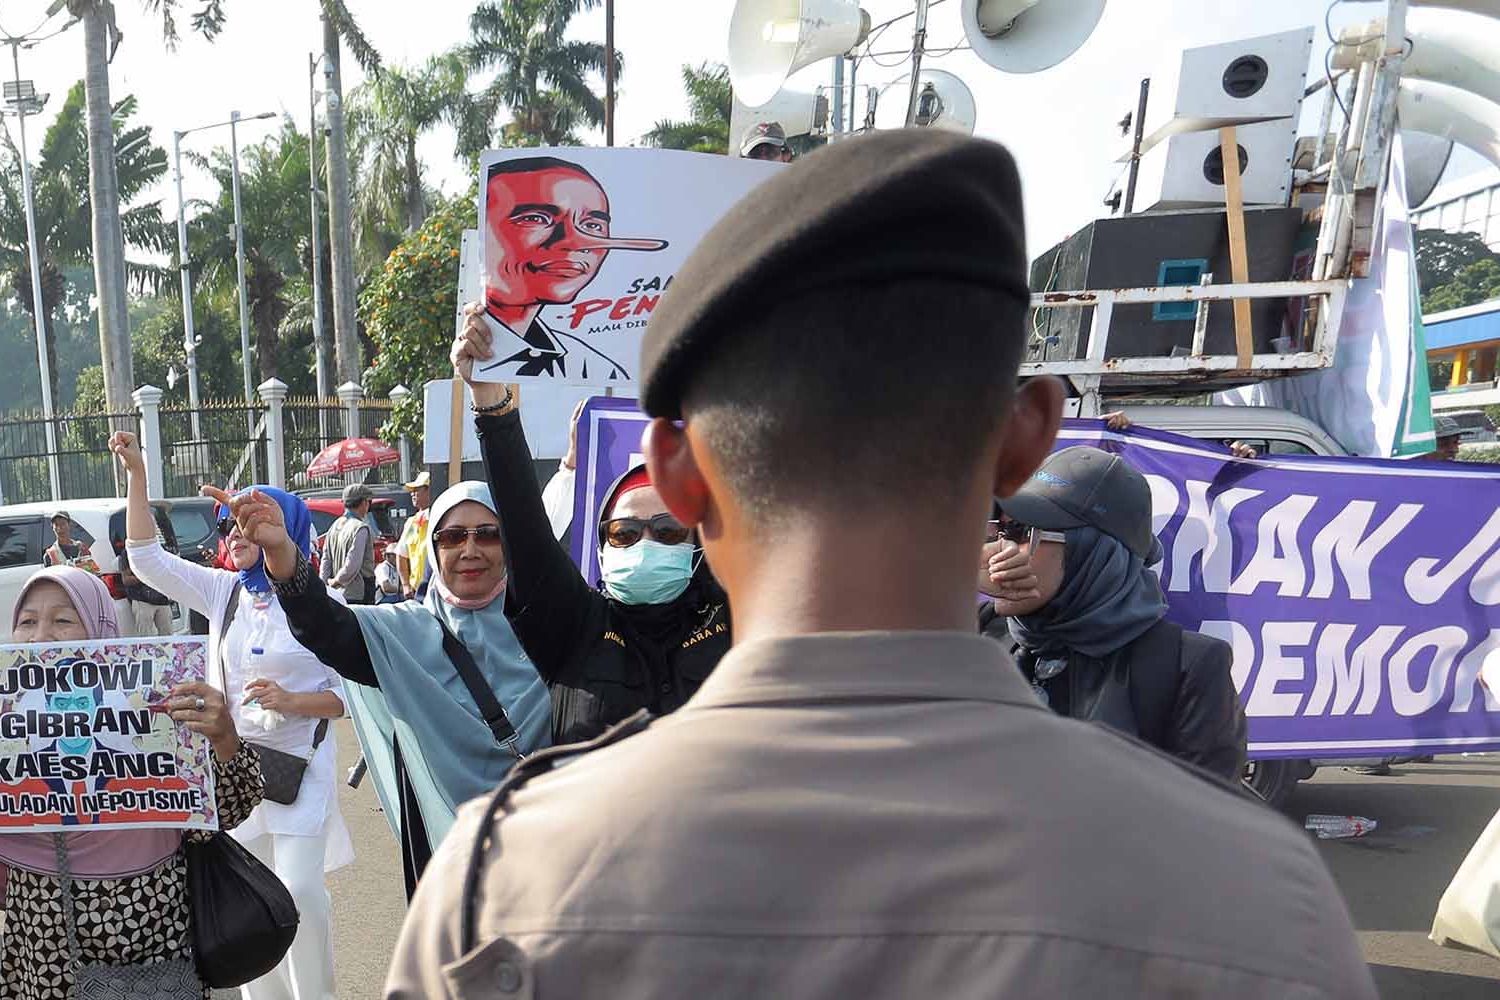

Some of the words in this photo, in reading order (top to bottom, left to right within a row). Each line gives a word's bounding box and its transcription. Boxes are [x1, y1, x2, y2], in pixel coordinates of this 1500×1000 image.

[627, 275, 673, 294] SA
[587, 323, 621, 335] MAU
[0, 705, 152, 740] GIBRAN
[80, 788, 202, 814] NEPOTISME
